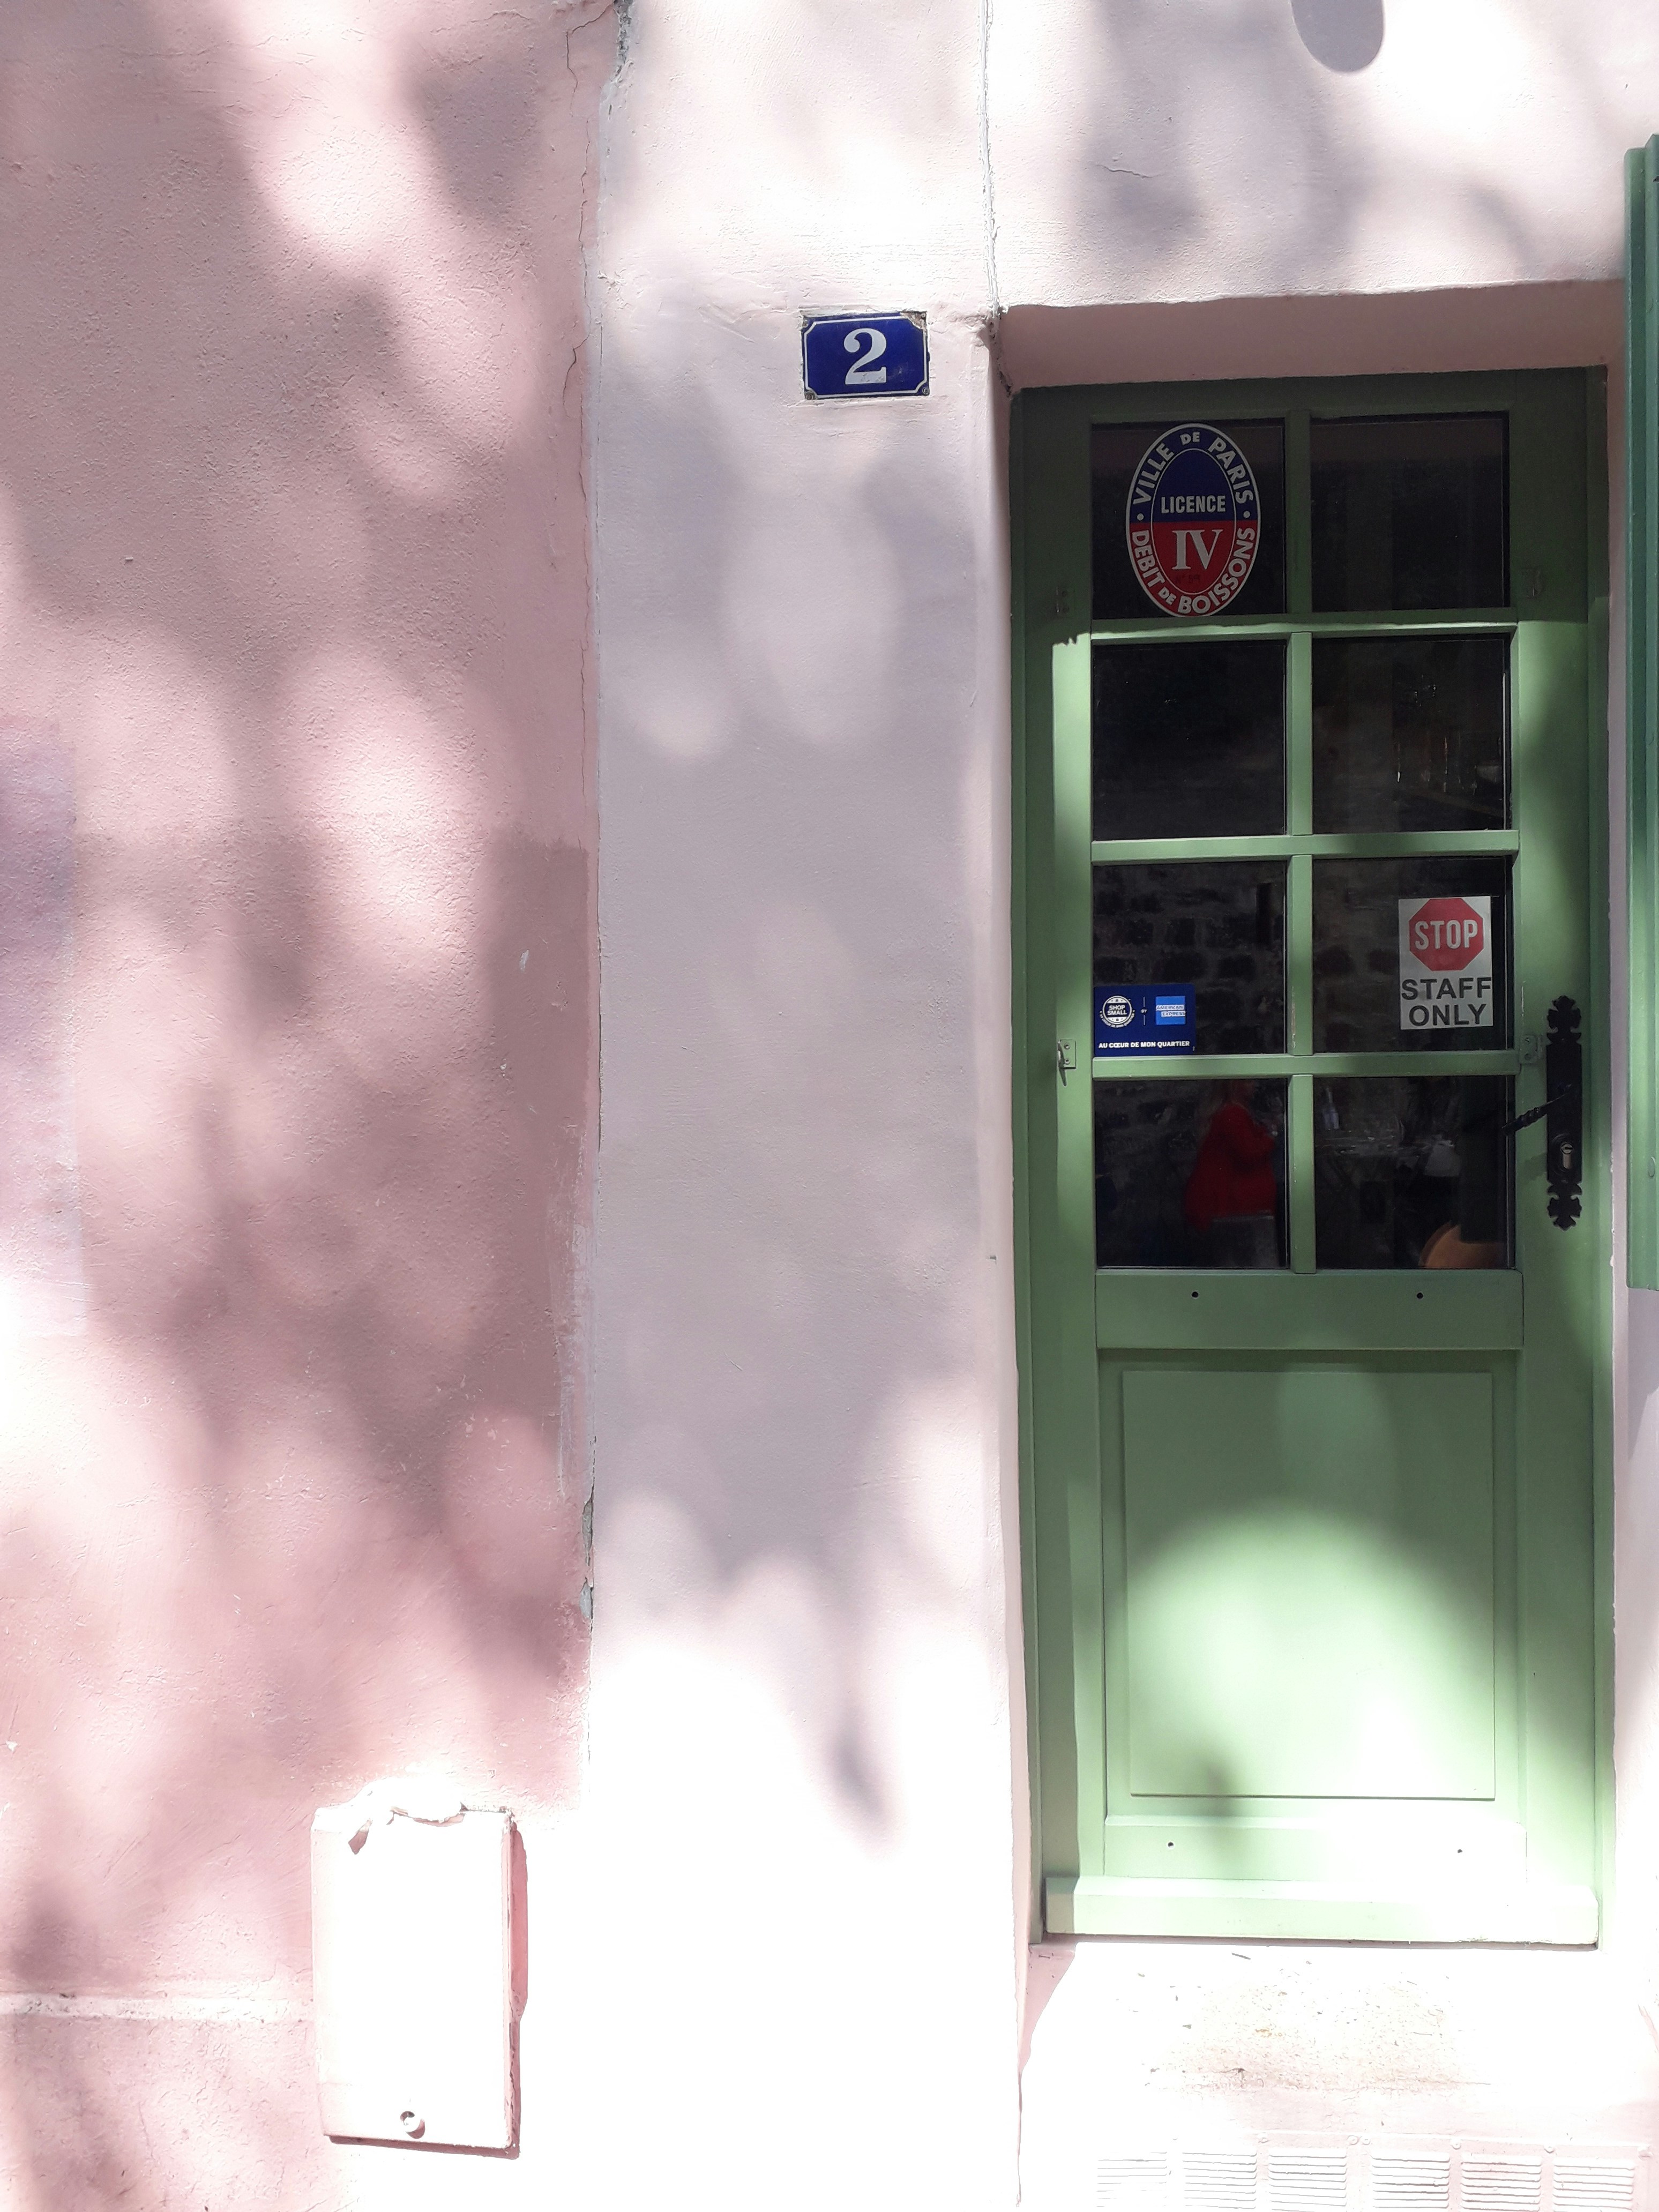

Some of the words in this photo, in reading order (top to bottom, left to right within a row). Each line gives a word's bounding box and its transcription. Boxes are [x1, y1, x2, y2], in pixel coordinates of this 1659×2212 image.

[843, 328, 887, 385] 2
[1133, 443, 1175, 505] VILLE
[1180, 432, 1200, 445] DE
[1207, 437, 1253, 504] PARIS
[1161, 496, 1226, 514] LICENCE
[1172, 529, 1223, 570] IV
[1132, 530, 1166, 587] DEBIT
[1158, 588, 1177, 604] DE
[1178, 527, 1256, 614] BOISSONS
[1415, 920, 1478, 950] STOP
[1401, 977, 1492, 1000] STAFF
[1409, 1003, 1486, 1026] ONLY
